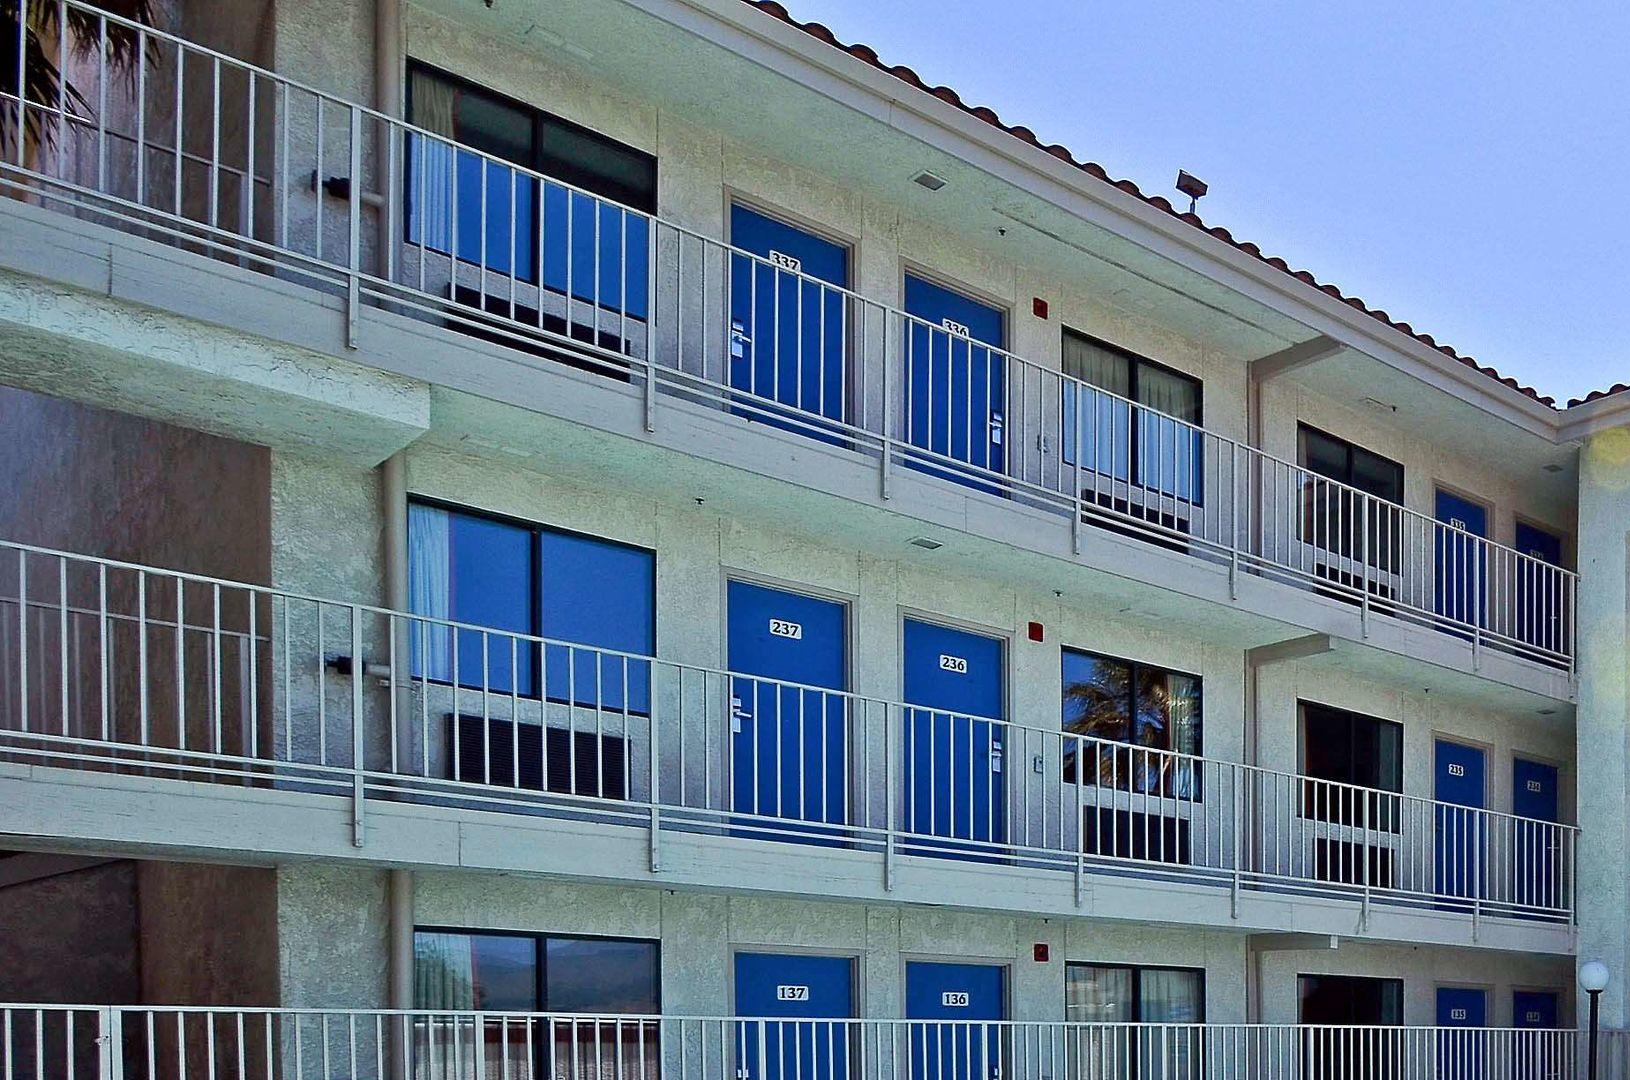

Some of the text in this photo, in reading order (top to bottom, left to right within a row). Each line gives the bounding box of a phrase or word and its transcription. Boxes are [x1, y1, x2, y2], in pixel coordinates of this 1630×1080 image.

[773, 252, 798, 269] 337
[772, 621, 799, 636] 237
[942, 657, 965, 671] 236
[1450, 765, 1462, 775] 235
[780, 987, 805, 998] 137
[945, 994, 966, 1004] 136
